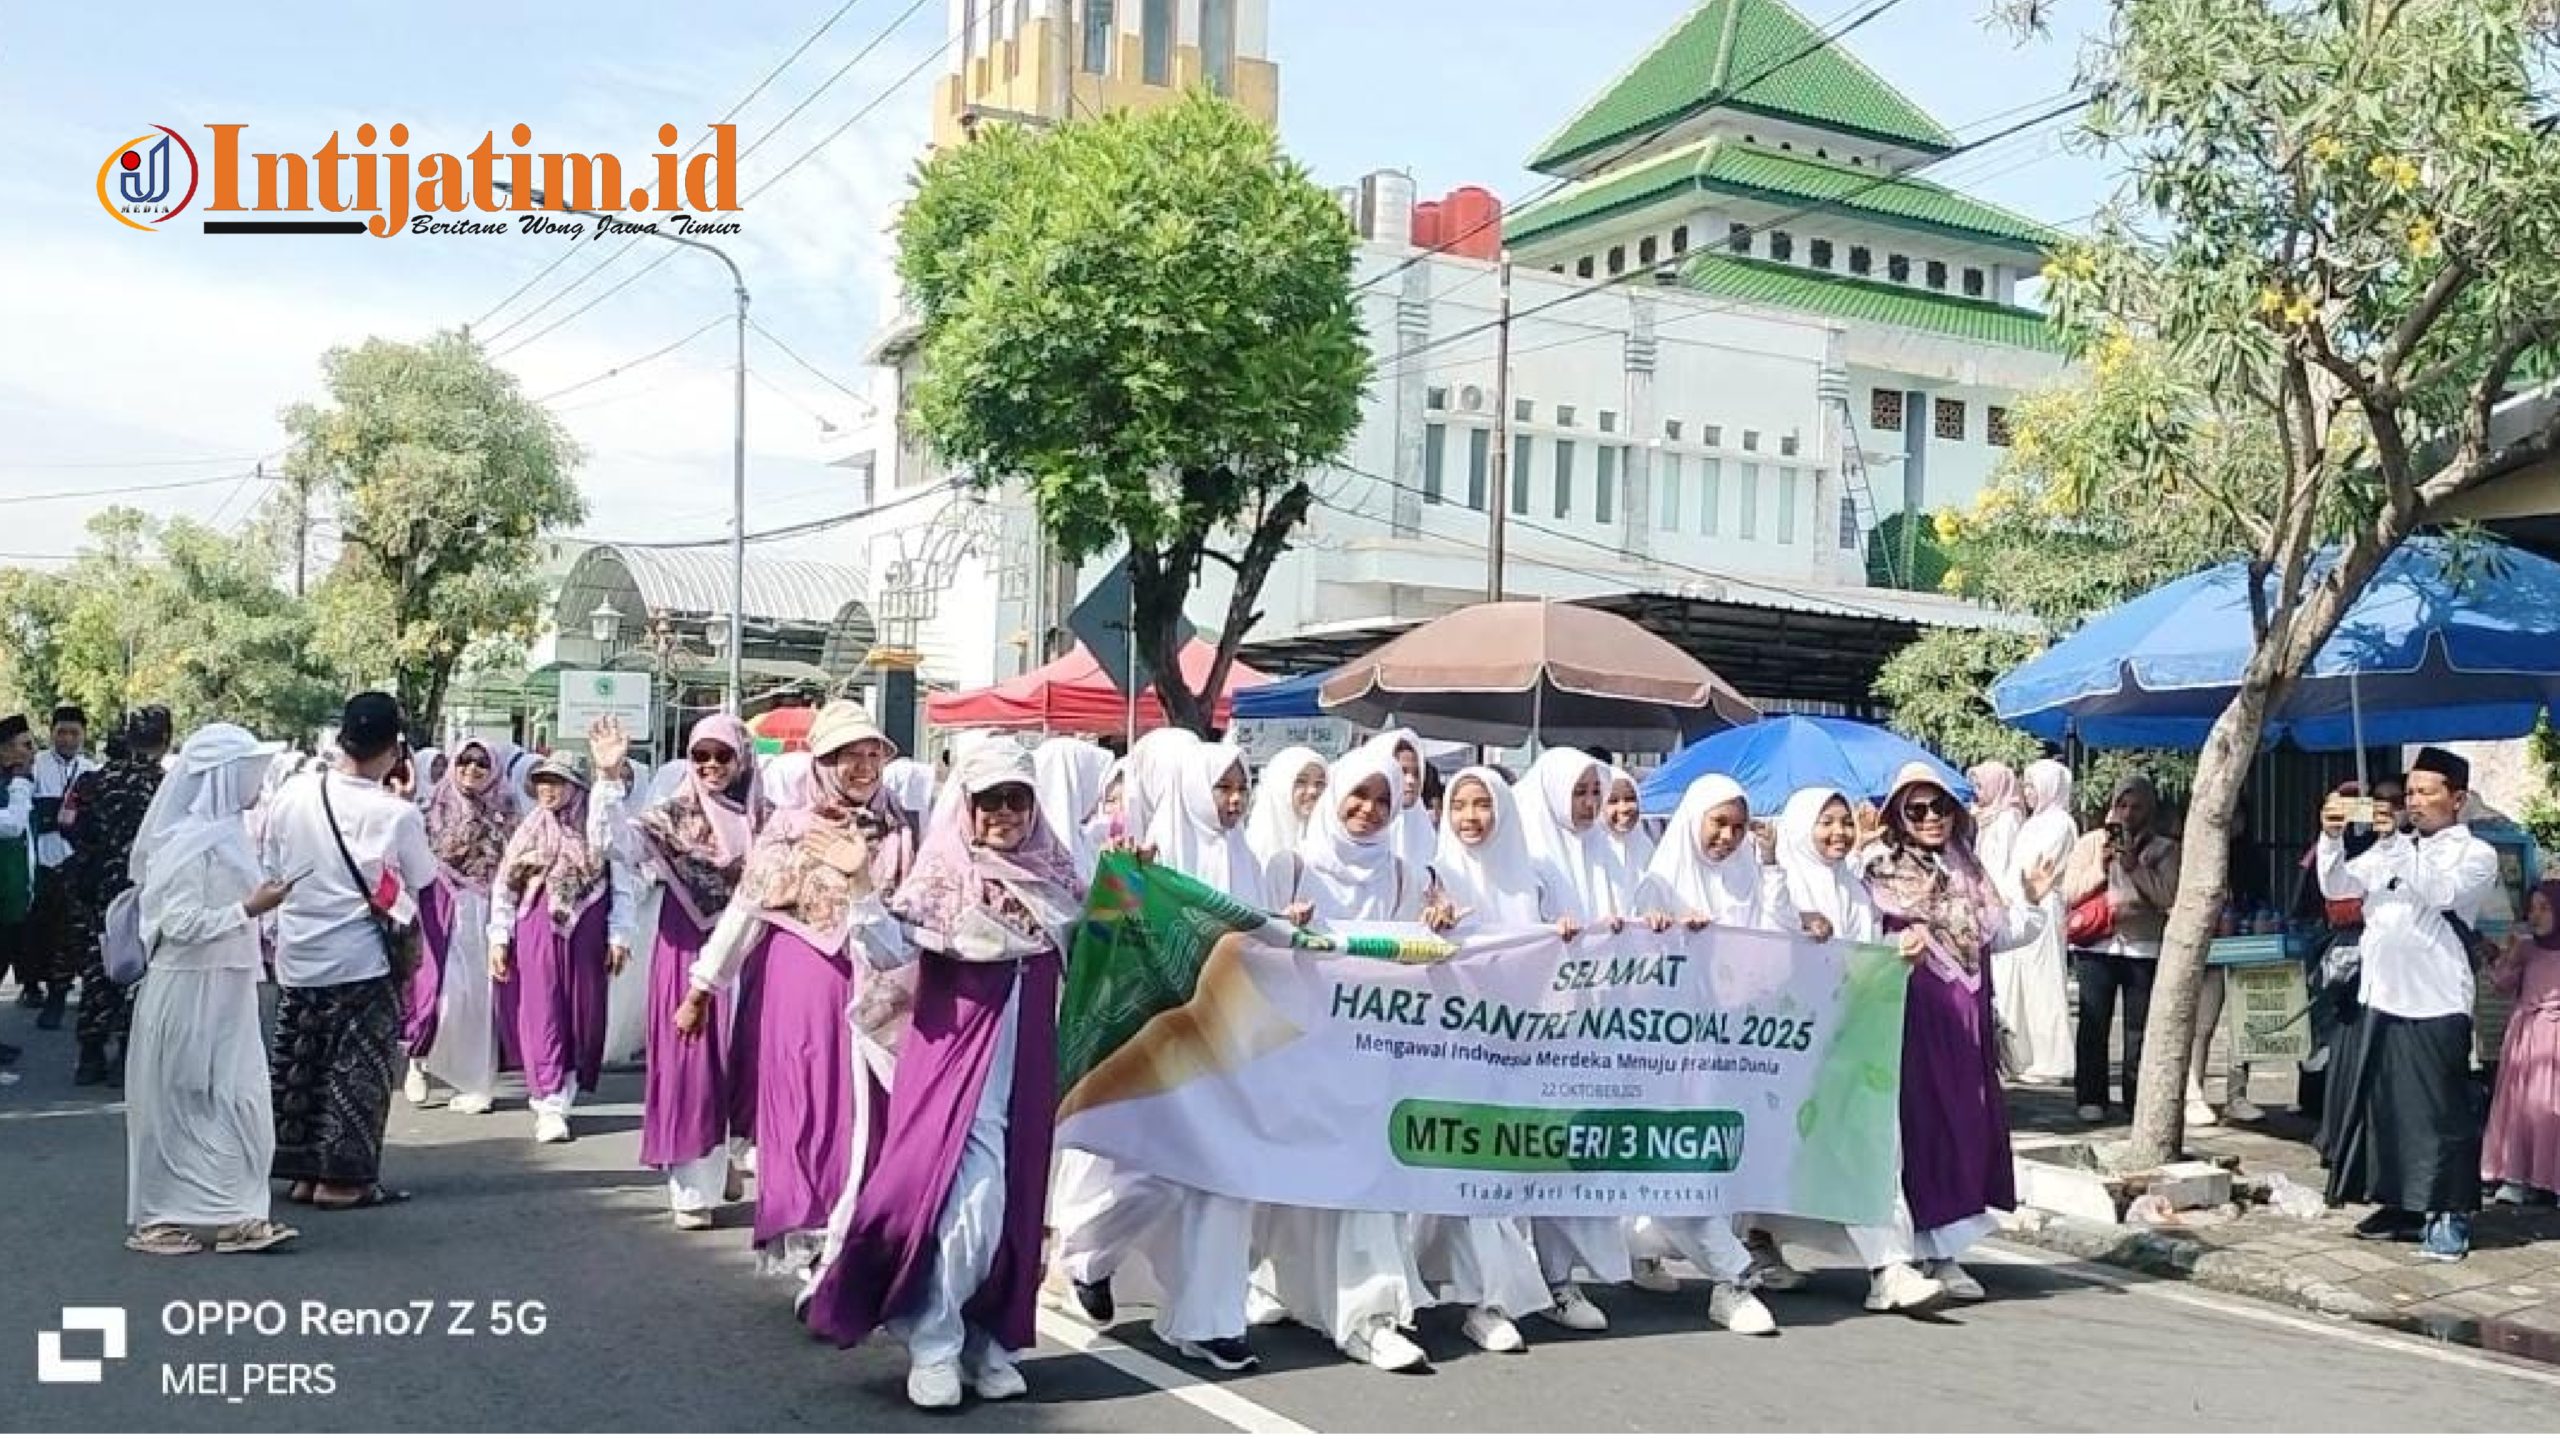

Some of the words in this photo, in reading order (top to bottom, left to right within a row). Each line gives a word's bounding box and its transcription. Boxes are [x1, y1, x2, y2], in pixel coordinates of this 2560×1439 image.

[1553, 955, 1687, 991] SELAMAT
[1330, 983, 1432, 1026] HARI
[1440, 996, 1577, 1042] SANTRI
[1578, 1007, 1730, 1045] NASIONAL
[1738, 1014, 1815, 1051] 2025
[1356, 1033, 1447, 1060] Mengawal
[1535, 1050, 1612, 1070] Merdeka
[1681, 1055, 1738, 1073] Praaban
[1739, 1056, 1780, 1076] Dunia
[1540, 1081, 1557, 1098] 22
[1406, 1114, 1481, 1155] MTs
[1495, 1121, 1612, 1160] NEGERI
[1618, 1124, 1638, 1159] 3
